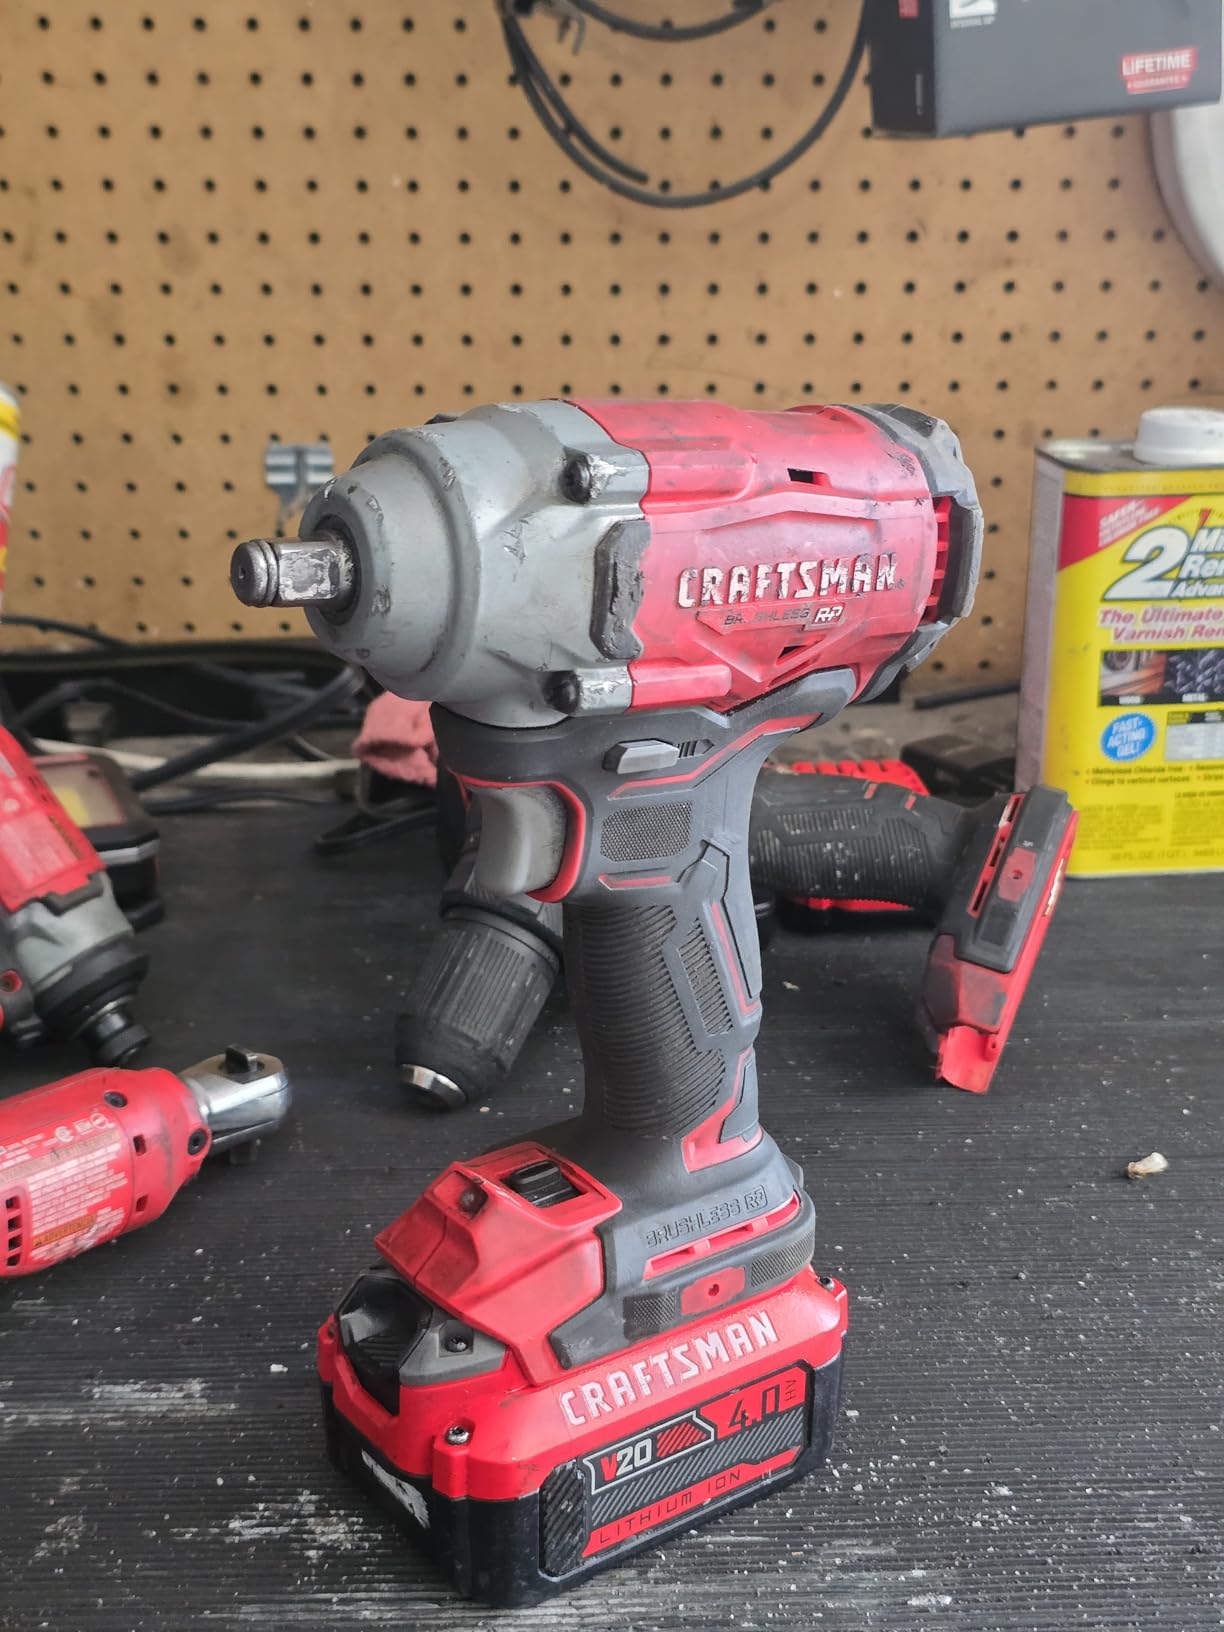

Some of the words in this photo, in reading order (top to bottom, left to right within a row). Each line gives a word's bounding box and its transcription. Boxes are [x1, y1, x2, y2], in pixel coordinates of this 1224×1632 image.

[1122, 53, 1191, 76] LIFETIME
[678, 551, 898, 608] CRAFTSMAN
[1101, 526, 1189, 600] 2
[1100, 609, 1135, 624] The
[1141, 607, 1224, 624] Ultimate
[1113, 627, 1185, 641] Varnish
[645, 1199, 741, 1248] BRUSHLESS
[559, 1310, 779, 1426] CRAFTSMAN
[600, 1438, 652, 1482] V20
[600, 1491, 693, 1545] LITHIUM
[707, 1469, 741, 1494] ION
